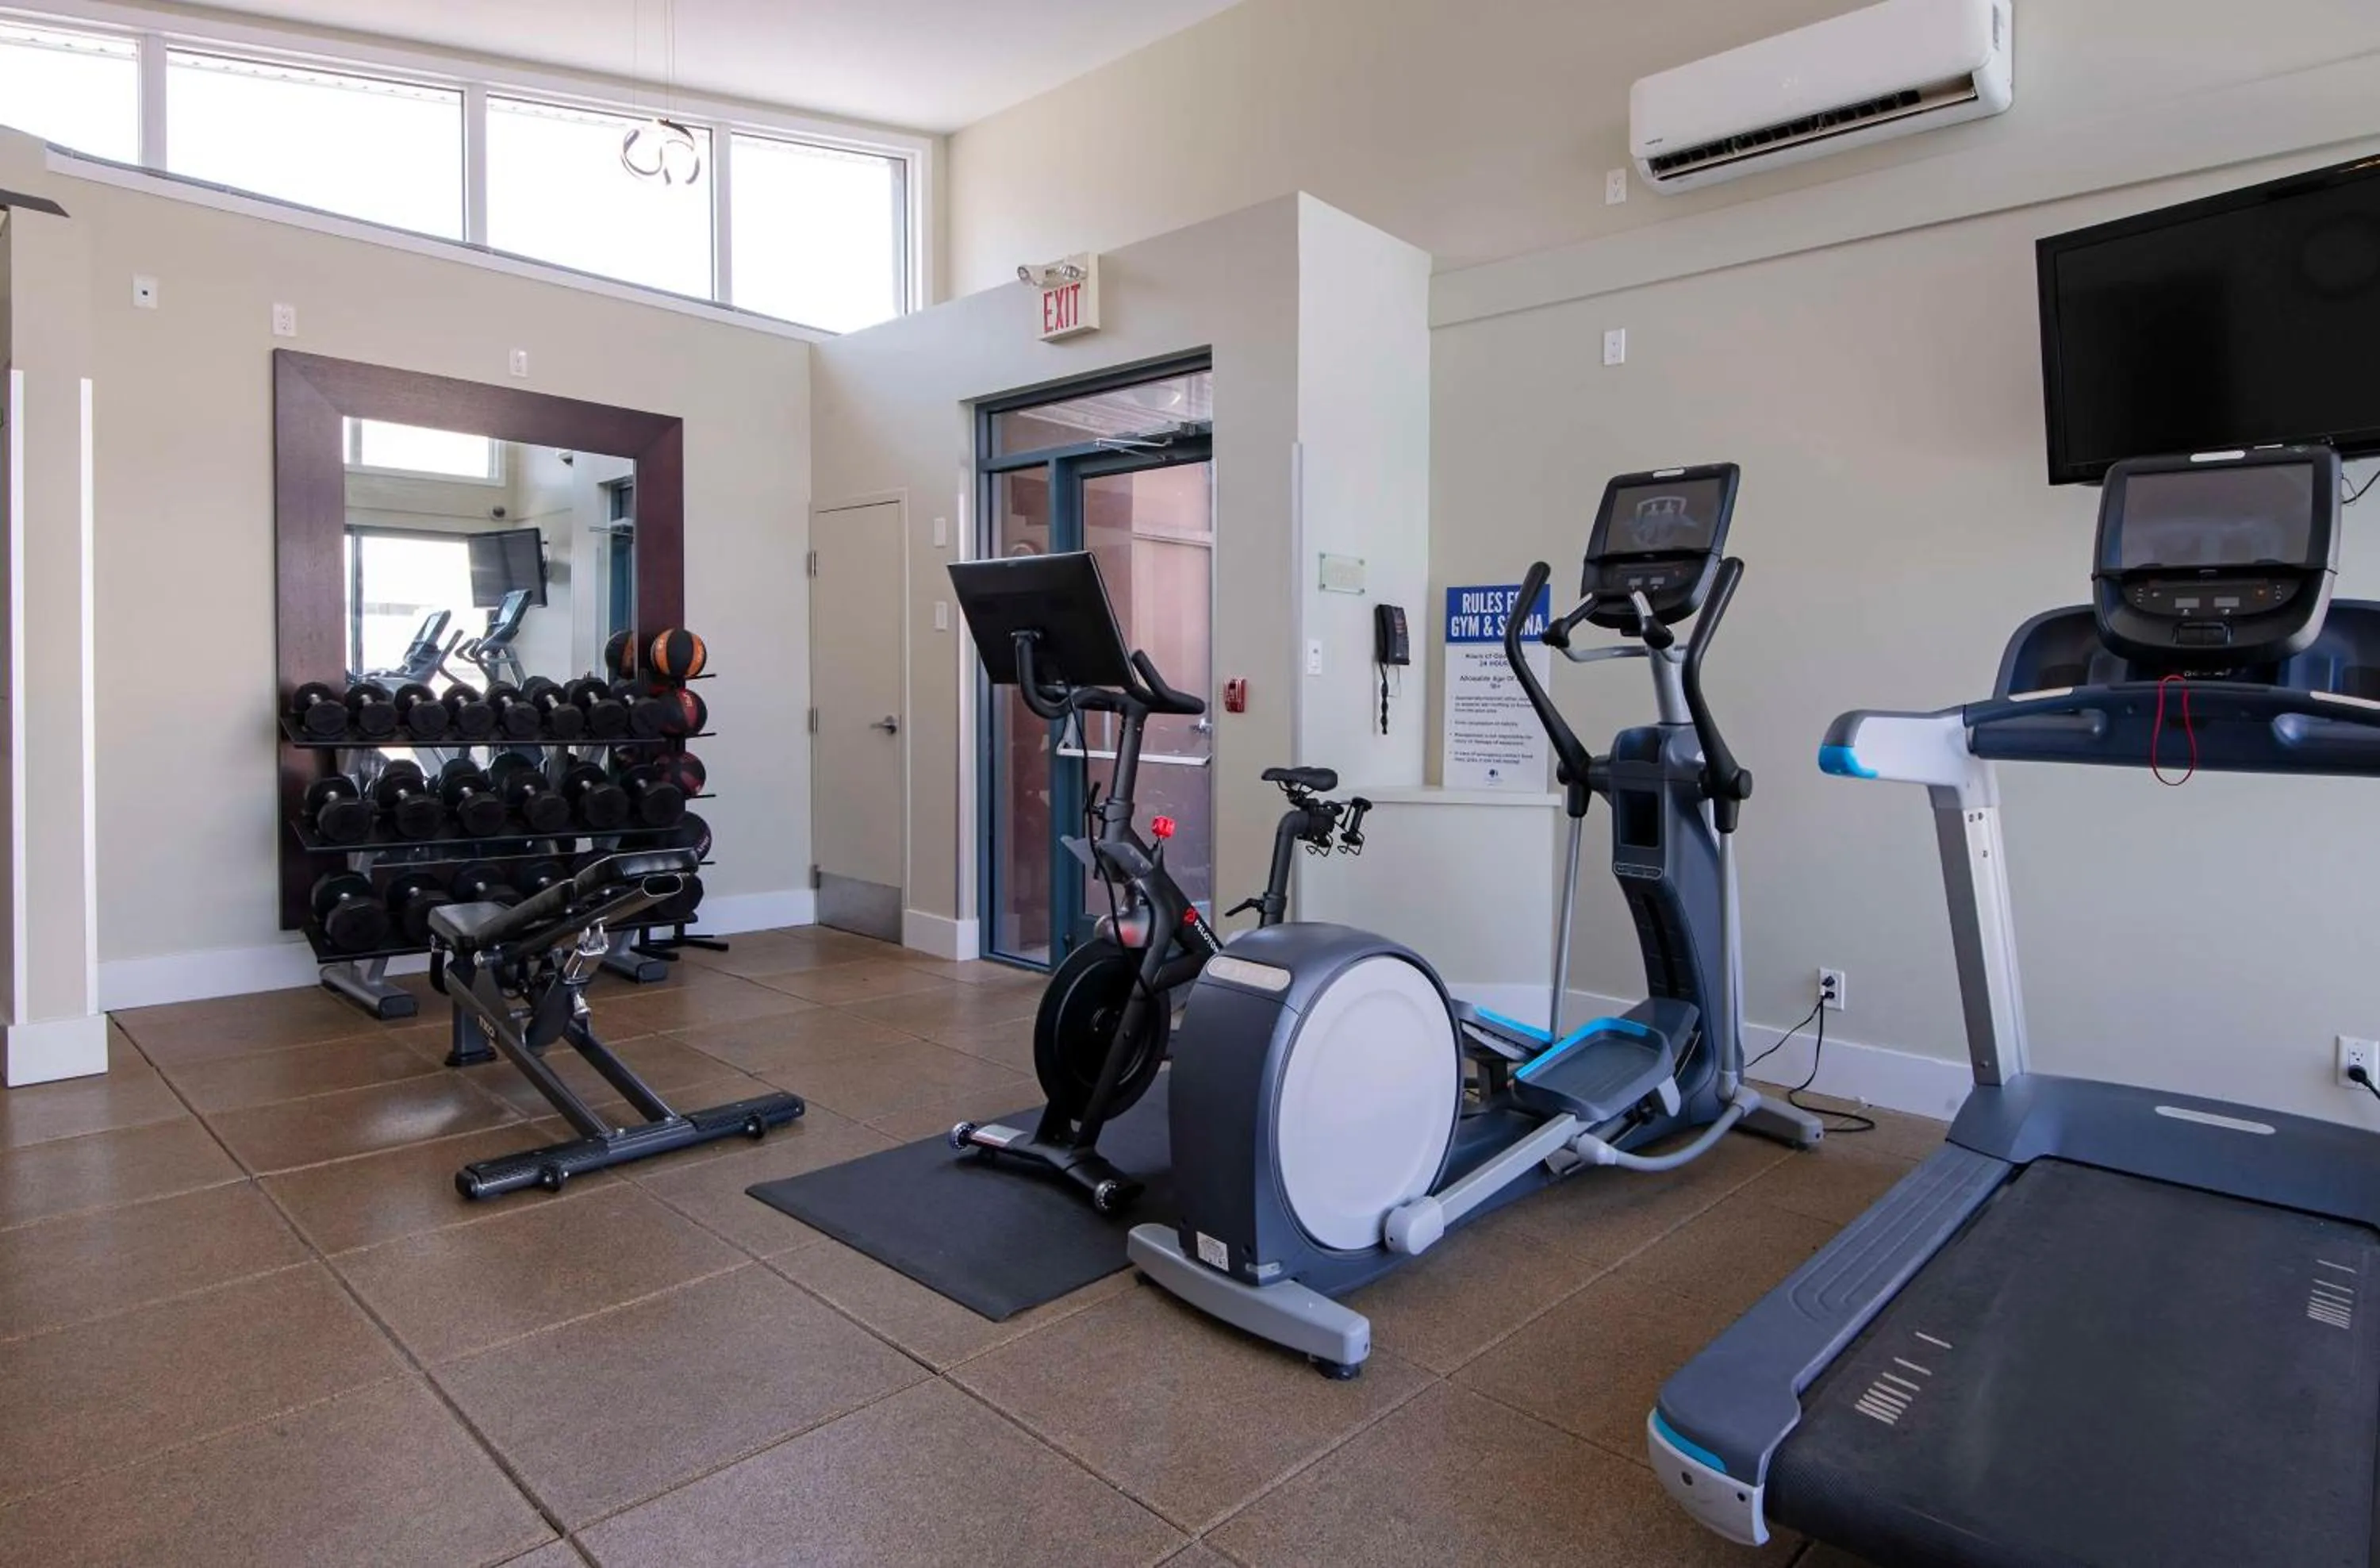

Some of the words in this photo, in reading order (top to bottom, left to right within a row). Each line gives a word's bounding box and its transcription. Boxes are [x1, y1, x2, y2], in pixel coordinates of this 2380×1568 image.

[1043, 282, 1081, 333] EXIT
[1462, 591, 1503, 613] RULES
[1451, 615, 1480, 637] GYM
[1483, 615, 1494, 637] &
[1497, 613, 1543, 636] SNA
